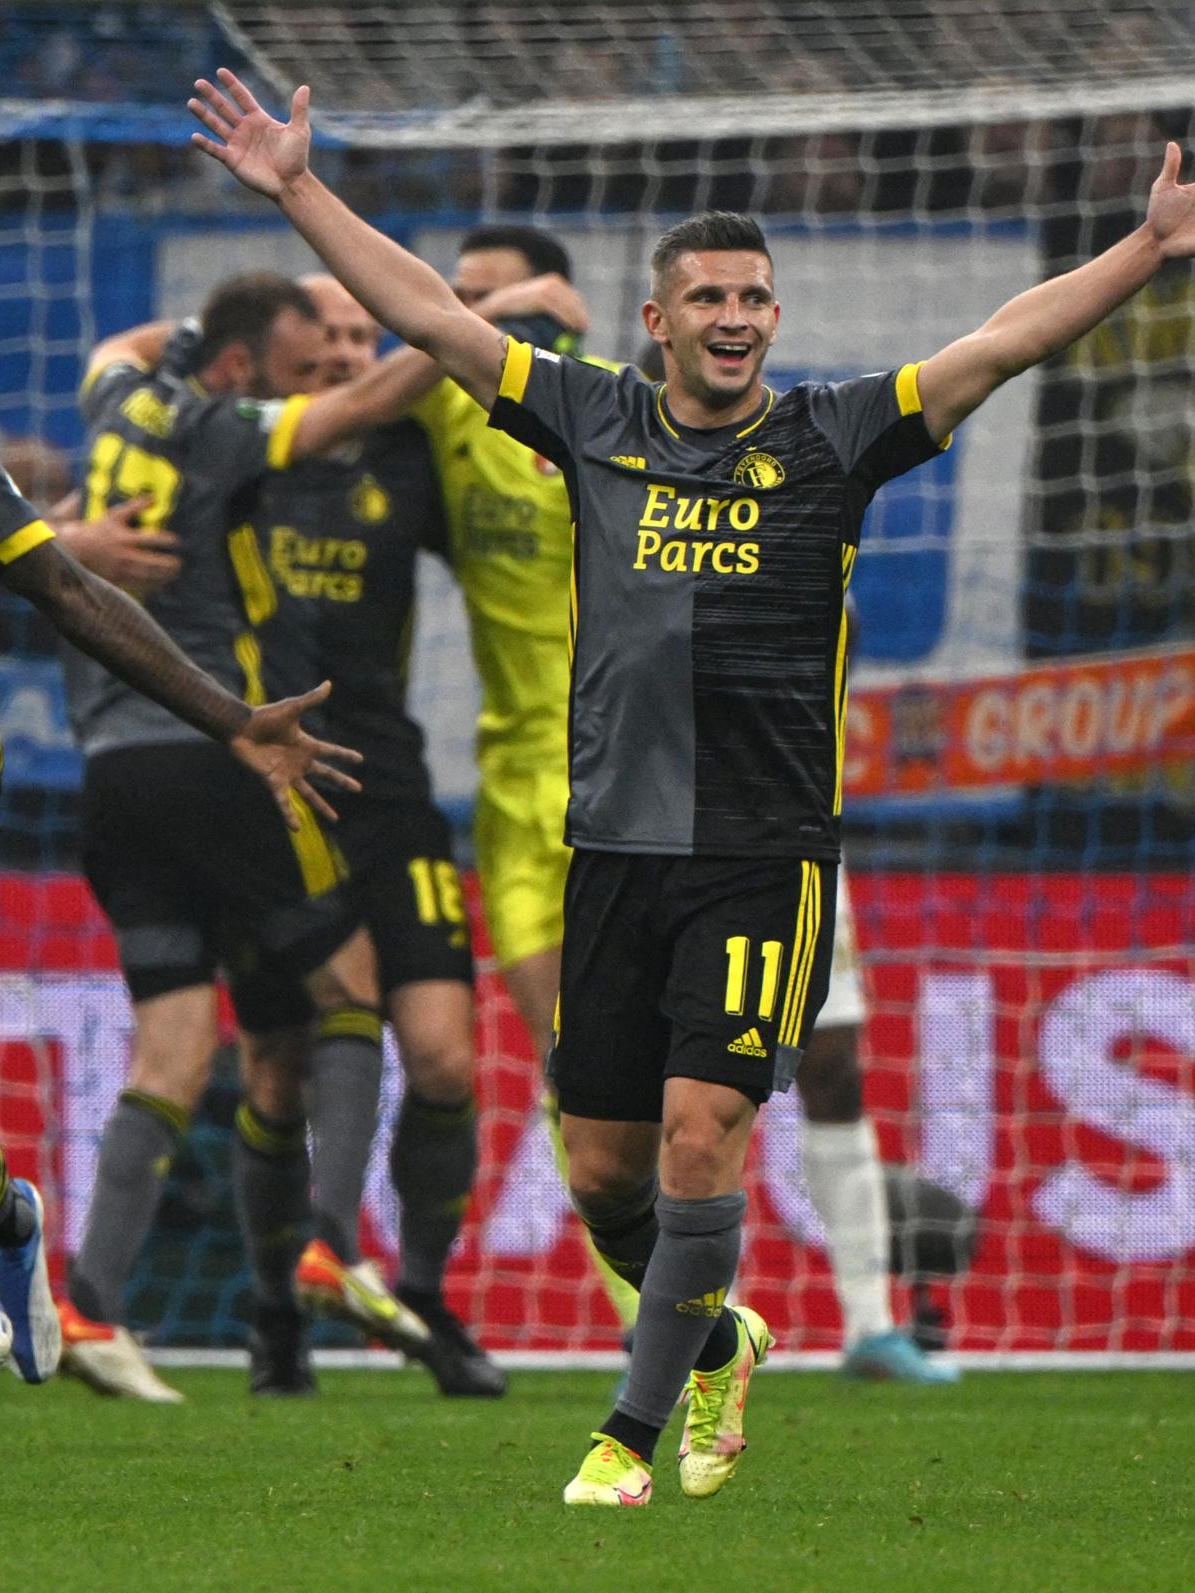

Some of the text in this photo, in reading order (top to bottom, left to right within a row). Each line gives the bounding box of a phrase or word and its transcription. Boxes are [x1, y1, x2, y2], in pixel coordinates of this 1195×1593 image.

[638, 483, 760, 532] Euro
[633, 529, 760, 575] Parcs
[725, 936, 784, 1023] 11
[727, 1043, 767, 1058] adidas
